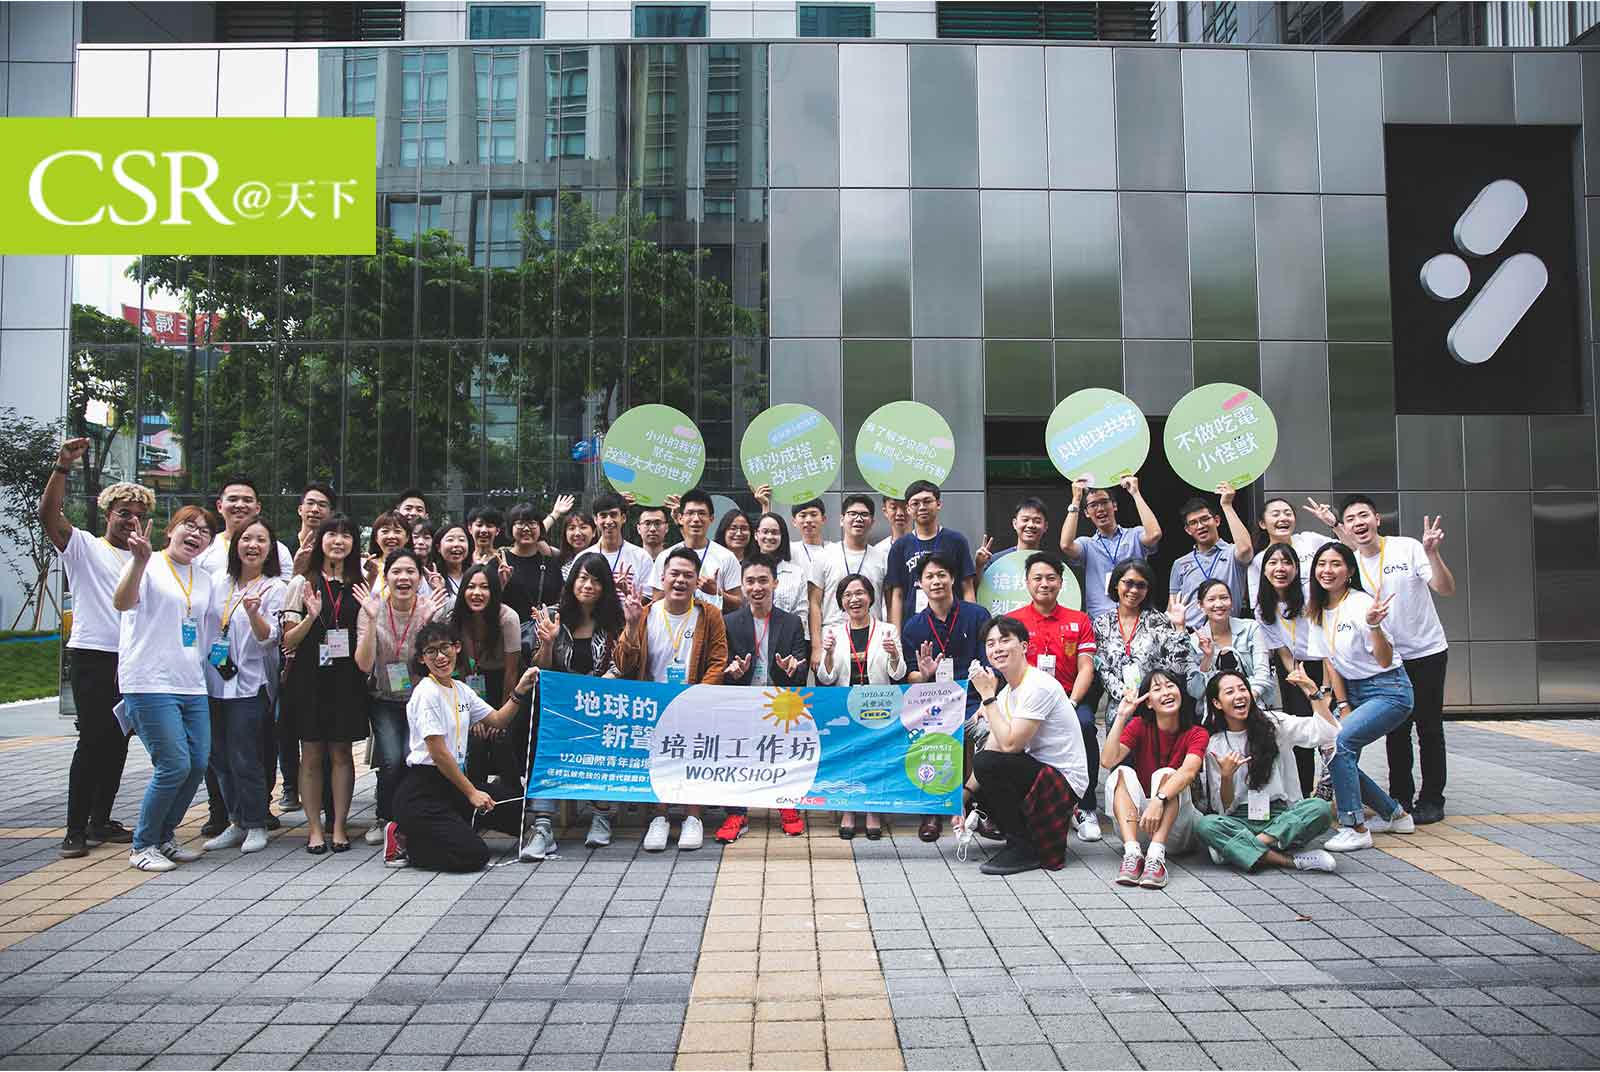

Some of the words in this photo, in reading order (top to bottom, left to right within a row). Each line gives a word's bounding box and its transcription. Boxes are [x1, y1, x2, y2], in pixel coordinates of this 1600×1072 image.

[1173, 405, 1258, 451] 不做吃電
[604, 446, 693, 485] 改變大大的世界
[747, 440, 812, 475] 積沙成塔
[1196, 431, 1259, 472] 小怪獸
[770, 454, 836, 486] 改變世界
[574, 689, 658, 722] 地球的
[862, 710, 889, 719] IKEA
[601, 723, 656, 750] 新聲
[660, 733, 817, 763] 培訓工作坊
[686, 766, 786, 783] WORKSHOP
